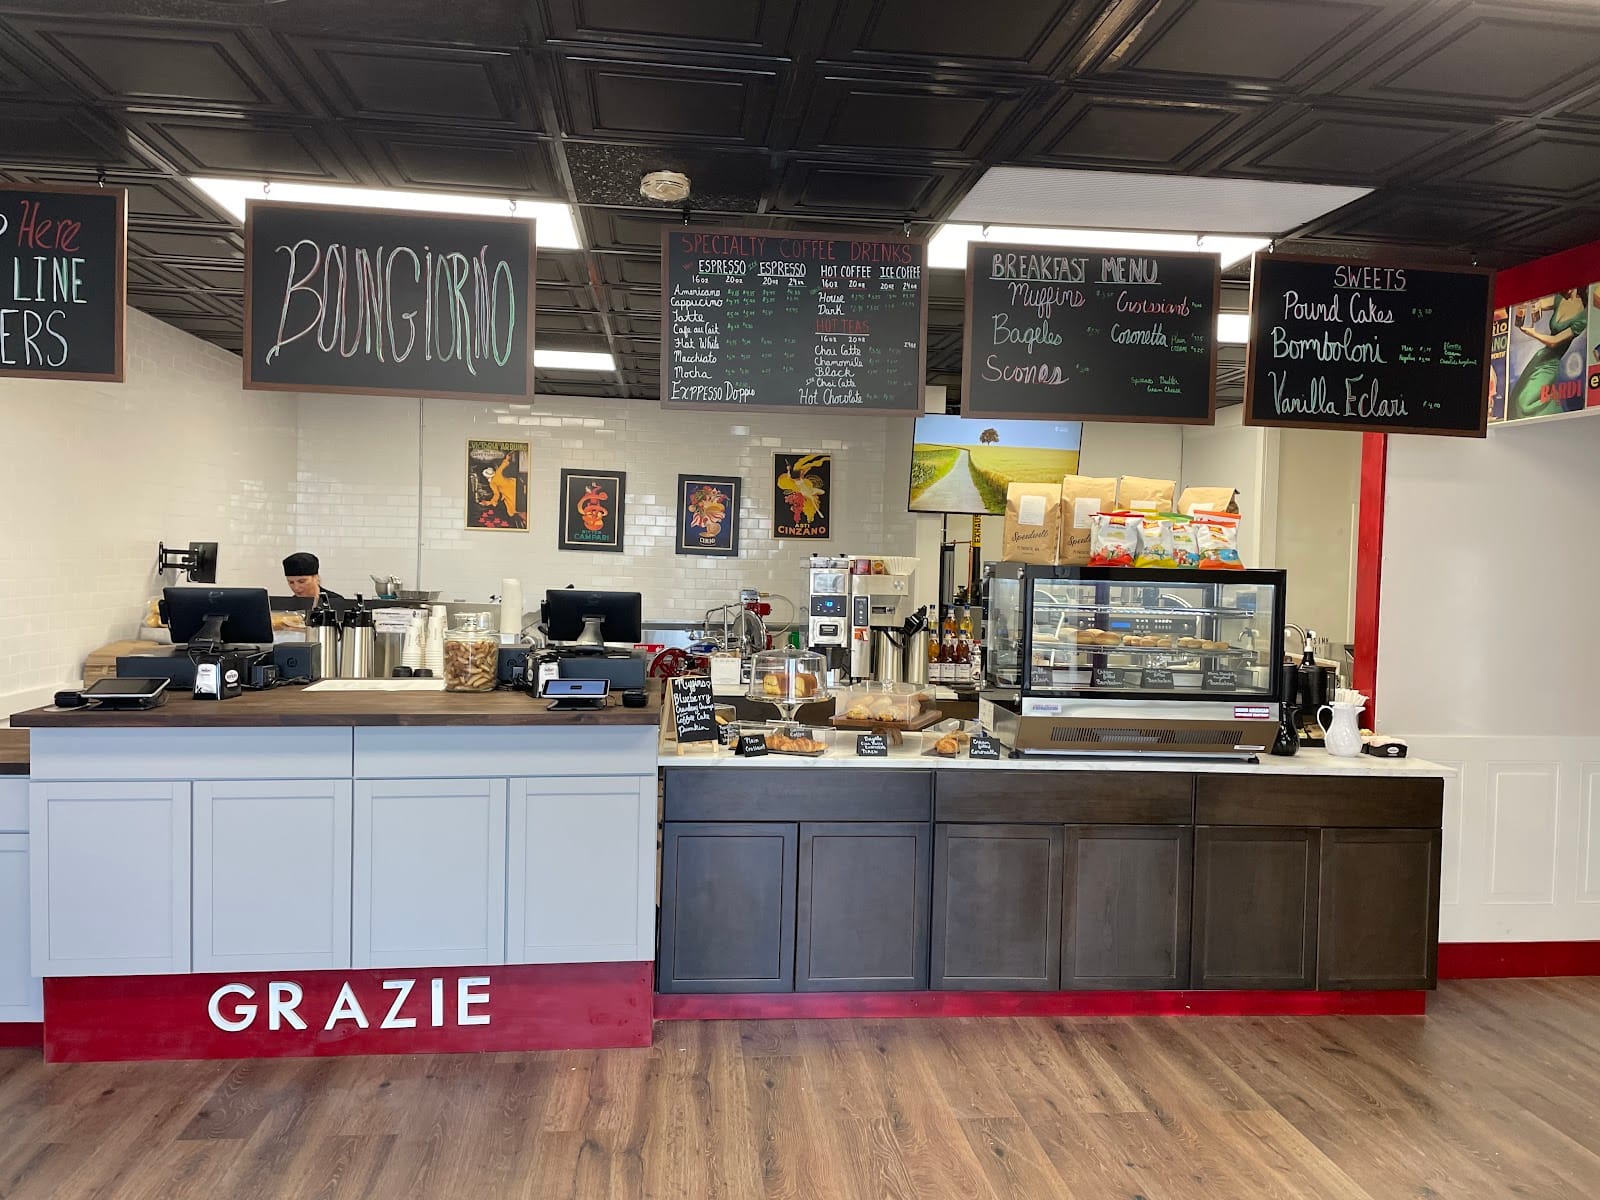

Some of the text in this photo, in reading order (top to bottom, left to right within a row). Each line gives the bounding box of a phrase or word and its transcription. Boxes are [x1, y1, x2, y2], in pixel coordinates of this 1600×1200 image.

[17, 199, 82, 253] Here
[681, 233, 913, 264] SPECIALTY COFFEE DRINKS
[698, 259, 747, 275] ESPRESSO
[758, 261, 807, 277] ESPRESSO
[820, 264, 872, 279] HOT COFFEE
[879, 266, 895, 279] ICE
[990, 253, 1160, 283] BREAKFAST MENU
[13, 256, 88, 304] LINE
[1333, 265, 1407, 290] SWEETS
[673, 284, 721, 297] Americano
[818, 291, 846, 304] House
[670, 296, 724, 311] Cappucino
[1007, 281, 1086, 319] Muffins
[1283, 290, 1344, 323] Pound
[1349, 292, 1395, 324] Cakes
[672, 309, 705, 323] Latte
[817, 304, 846, 316] Dark
[673, 323, 692, 338] Cafe
[693, 325, 704, 334] au
[815, 318, 871, 334] HOT TEAS
[673, 337, 696, 349] Flat
[699, 336, 720, 350] White
[814, 344, 838, 356] Chai
[1270, 326, 1388, 364] Bomboloni
[673, 349, 718, 364] Macchiato
[814, 356, 864, 368] Chamomile
[673, 365, 713, 379] Mocha
[814, 366, 855, 378] Black
[981, 354, 1070, 385] Scones
[816, 377, 837, 388] Chai
[723, 380, 756, 403] Doppio
[798, 388, 819, 405] Hot
[822, 388, 864, 405] Chocolate
[1267, 370, 1340, 416] Vanilla
[574, 533, 609, 541] CAMPARI
[777, 525, 827, 536] CINZANO
[673, 692, 712, 706] Blueberry
[207, 975, 491, 1032] GRAZIE
